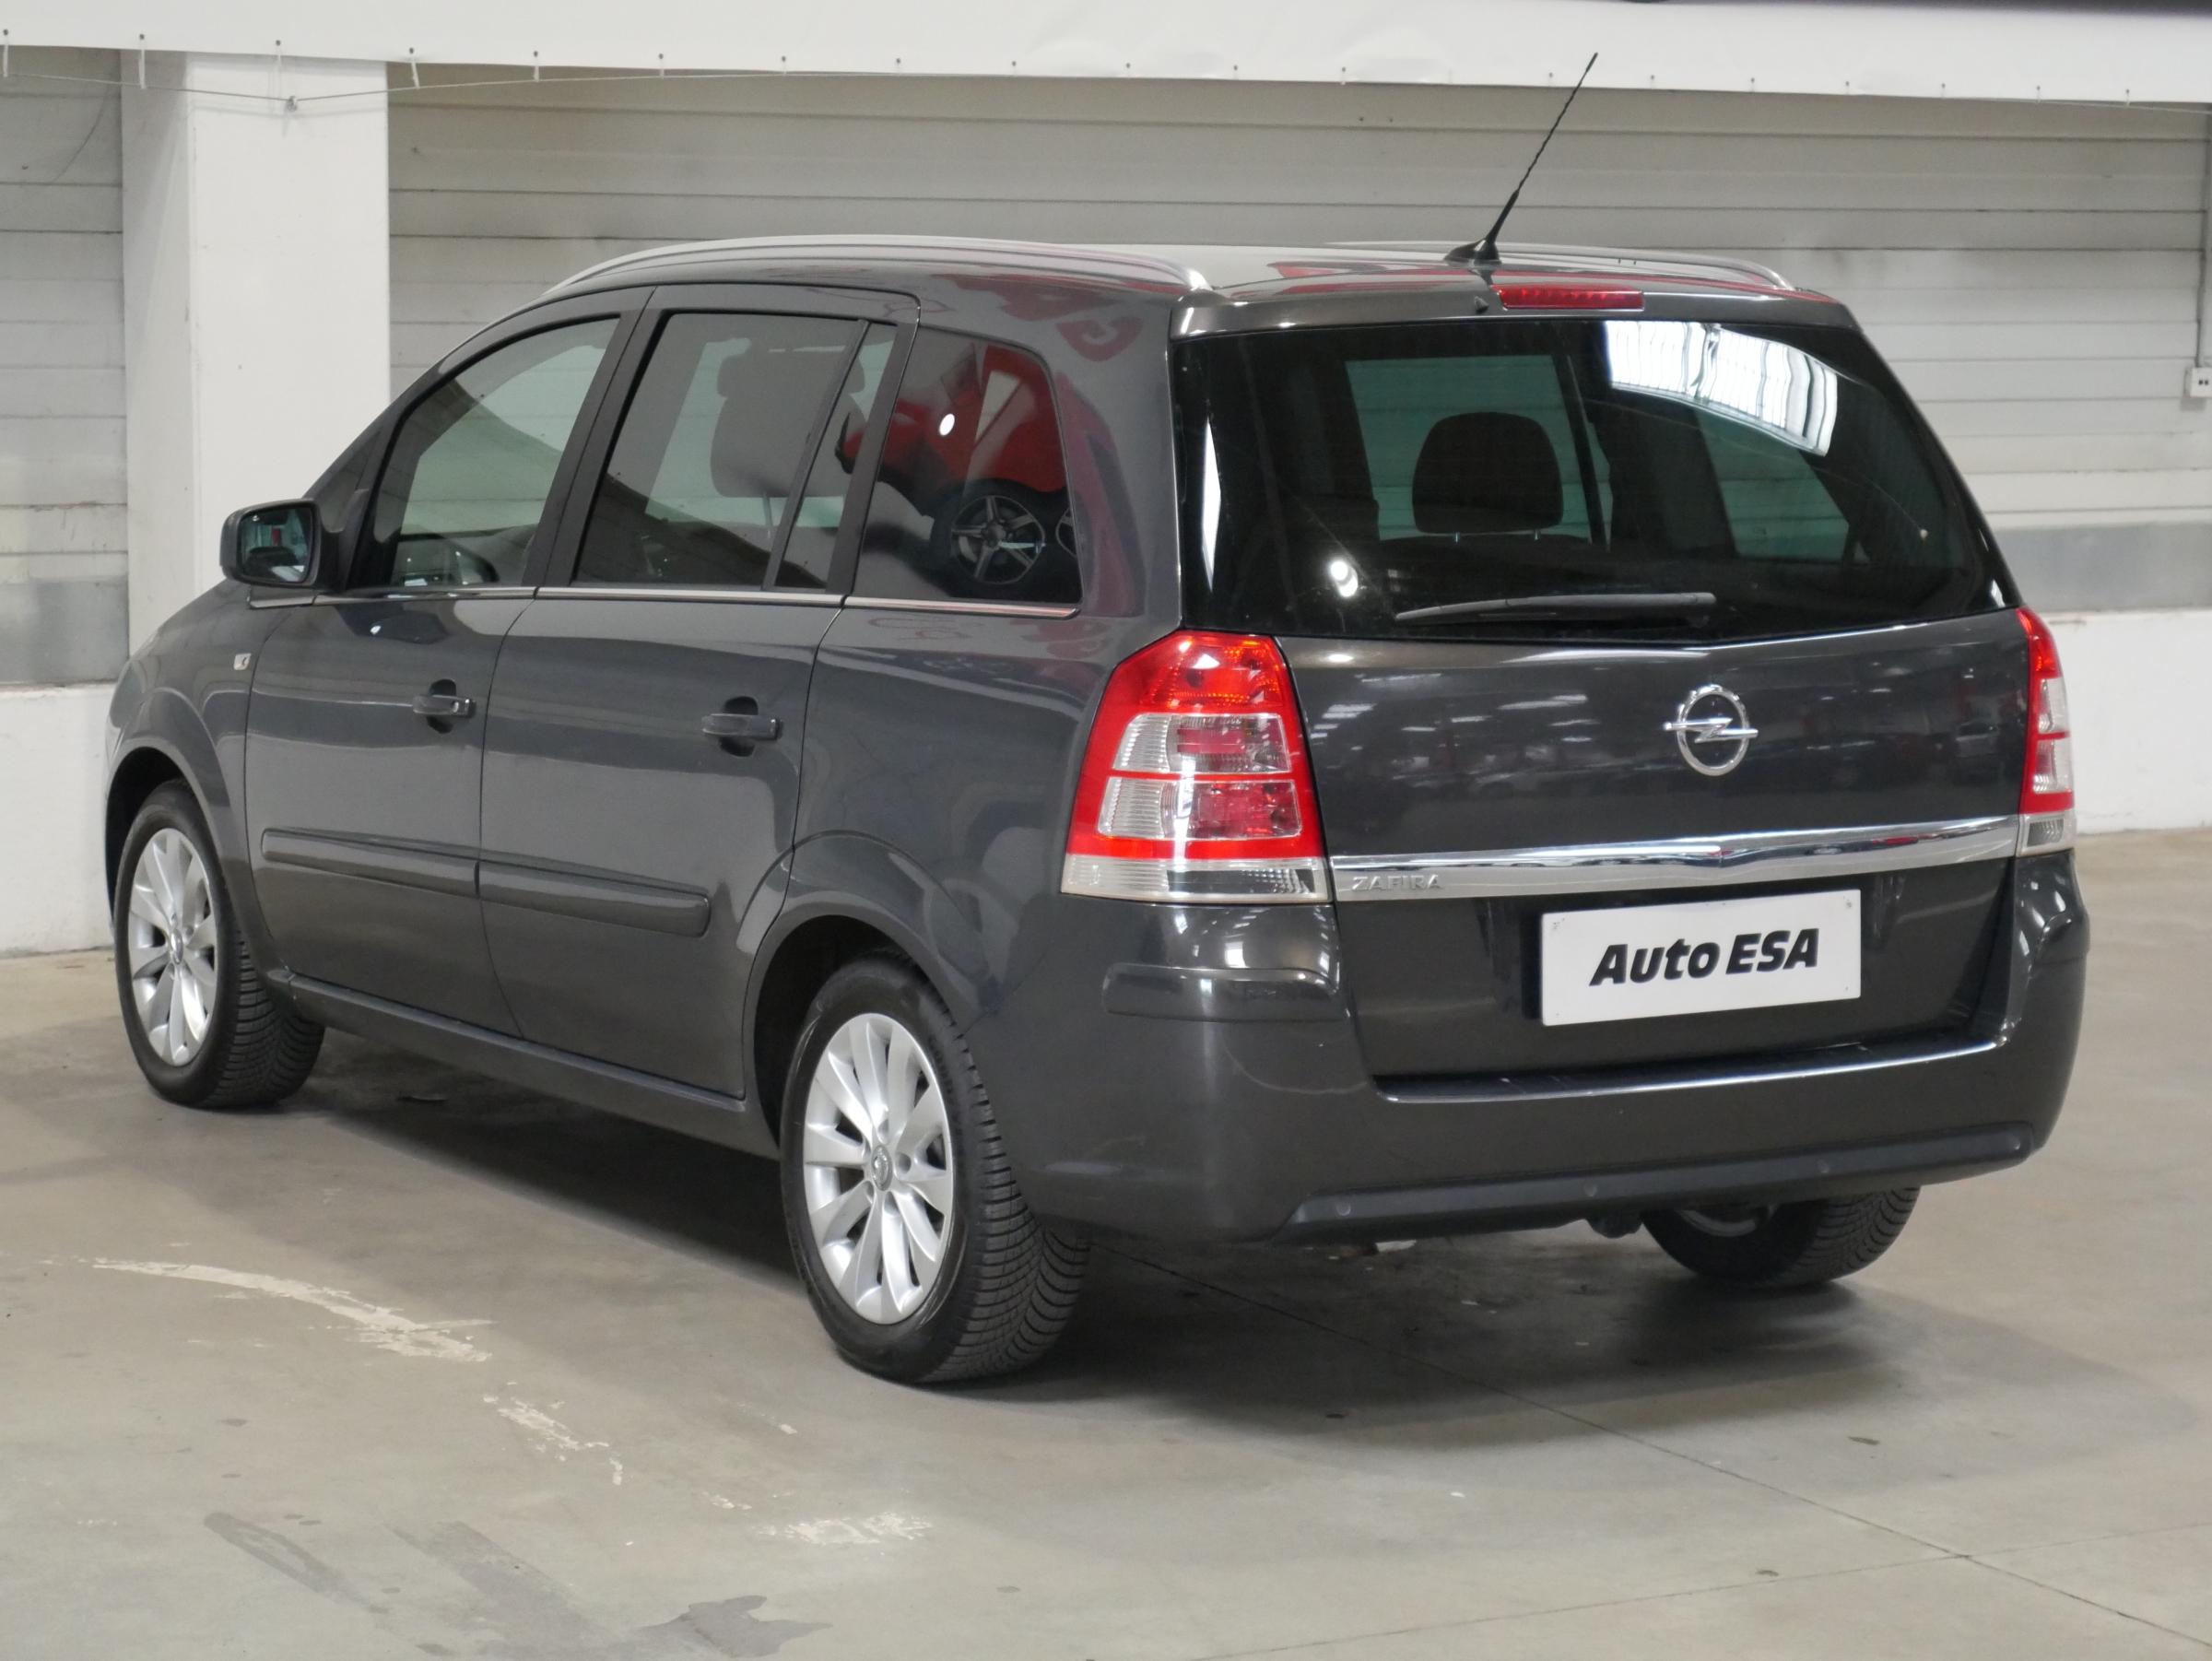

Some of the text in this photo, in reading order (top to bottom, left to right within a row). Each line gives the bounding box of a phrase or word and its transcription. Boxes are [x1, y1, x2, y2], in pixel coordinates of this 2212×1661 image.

[1351, 874, 1441, 891] ZAFIRA
[1589, 927, 1819, 986] Auto ESA
